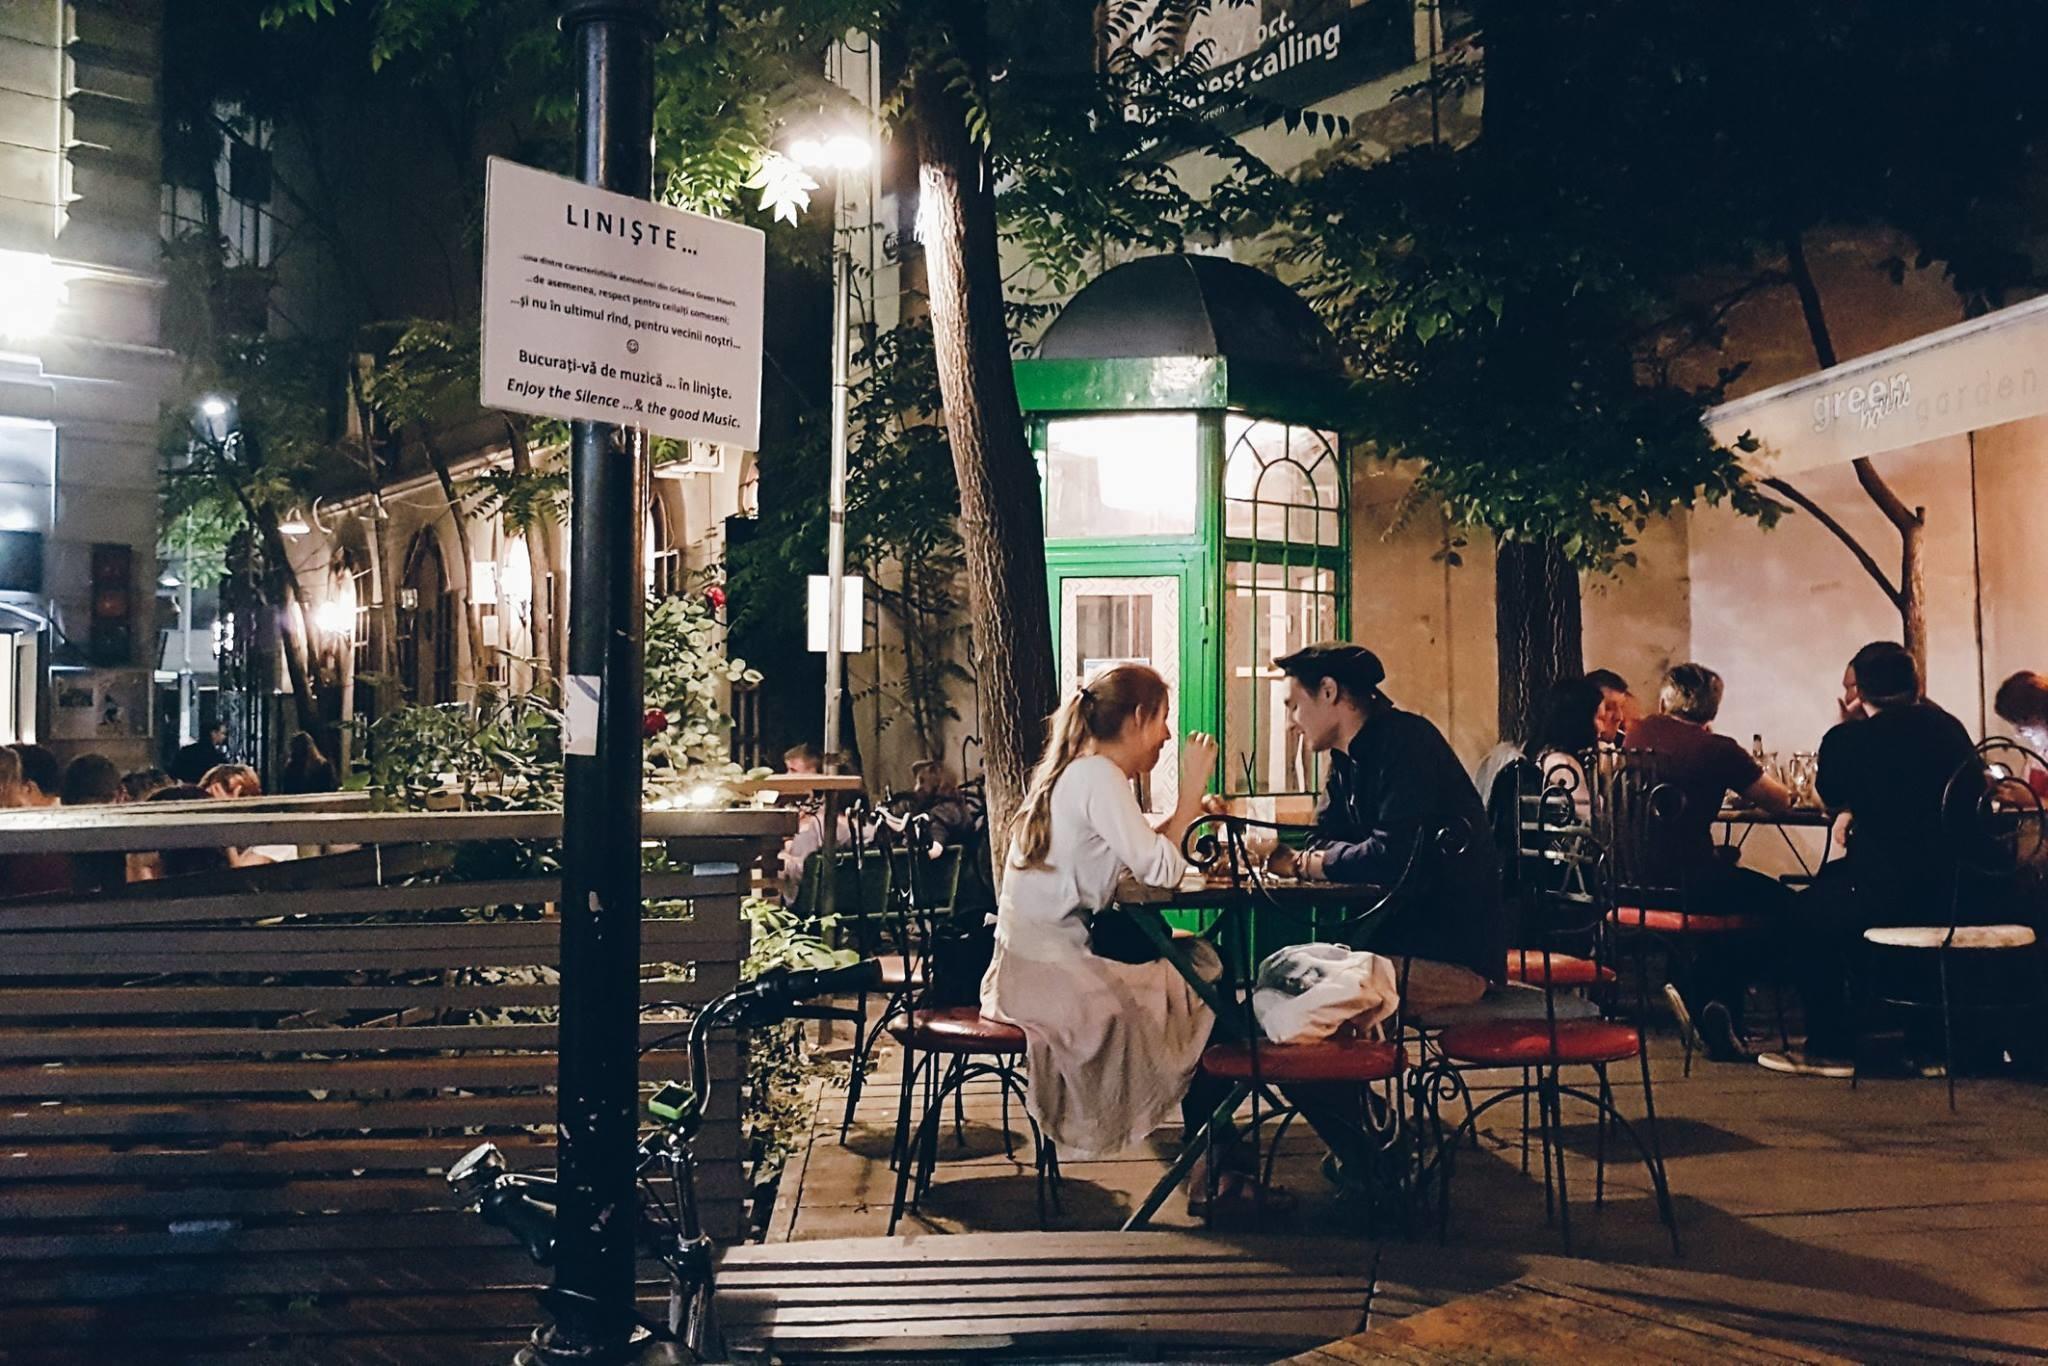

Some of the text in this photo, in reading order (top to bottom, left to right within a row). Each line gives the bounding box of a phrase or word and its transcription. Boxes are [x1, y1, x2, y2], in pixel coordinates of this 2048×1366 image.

[1250, 22, 1341, 80] calling
[540, 257, 563, 268] dintre
[657, 282, 668, 291] din
[696, 291, 715, 303] Green
[547, 280, 596, 296] asemenea,
[598, 288, 630, 303] respect
[632, 296, 661, 309] pentru
[532, 298, 547, 310] nu
[550, 299, 561, 313] în
[564, 304, 604, 321] ultimul
[607, 311, 631, 329] rînd,
[634, 318, 668, 334] pentru
[671, 327, 702, 342] vecinii
[600, 364, 617, 379] de
[620, 369, 662, 387] muzică
[679, 377, 690, 392] în
[1813, 368, 2037, 431] green garden
[507, 378, 545, 399] Enjoy
[549, 384, 571, 400] the
[574, 389, 620, 408] Silence
[647, 402, 667, 416] the
[670, 407, 700, 421] good
[702, 411, 741, 428] Music.
